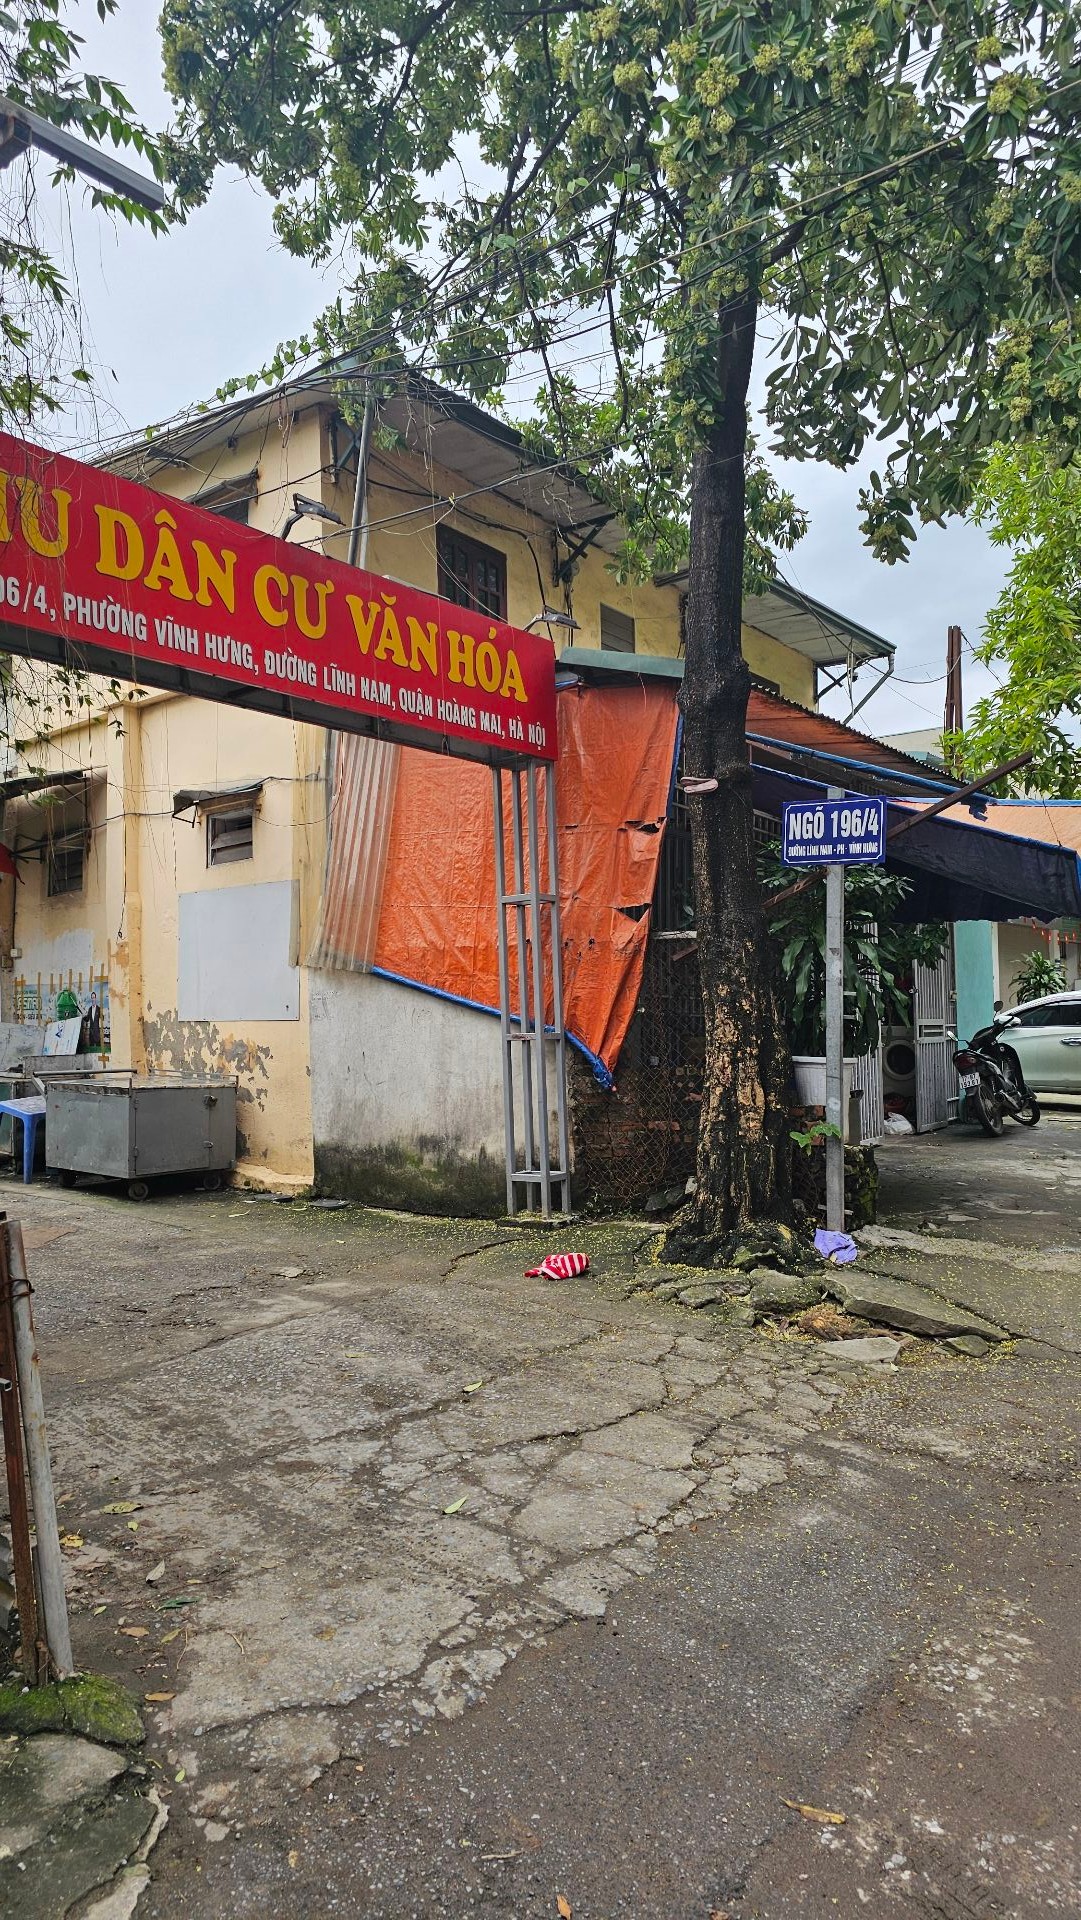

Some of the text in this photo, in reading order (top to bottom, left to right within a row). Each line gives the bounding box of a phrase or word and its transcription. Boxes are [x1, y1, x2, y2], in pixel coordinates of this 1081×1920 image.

[93, 504, 238, 614] DÂN
[253, 564, 335, 640] CƯ
[345, 591, 439, 676] VĂN
[446, 626, 529, 703] HÓA
[63, 592, 148, 642] PHƯỜNG
[154, 615, 199, 656] VĨNH
[204, 632, 259, 676] HƯNG,
[264, 648, 317, 687] ĐƯỜNG
[323, 663, 356, 698] LĨNH
[360, 677, 396, 711] NAM,
[398, 687, 433, 721] QUẬN
[437, 697, 476, 729] HOÀNG
[480, 711, 505, 738] MAI,
[508, 712, 524, 741] HÀ
[528, 723, 546, 753] NỘI
[789, 806, 878, 840] NGÕ 196/4
[820, 844, 833, 856] NAM
